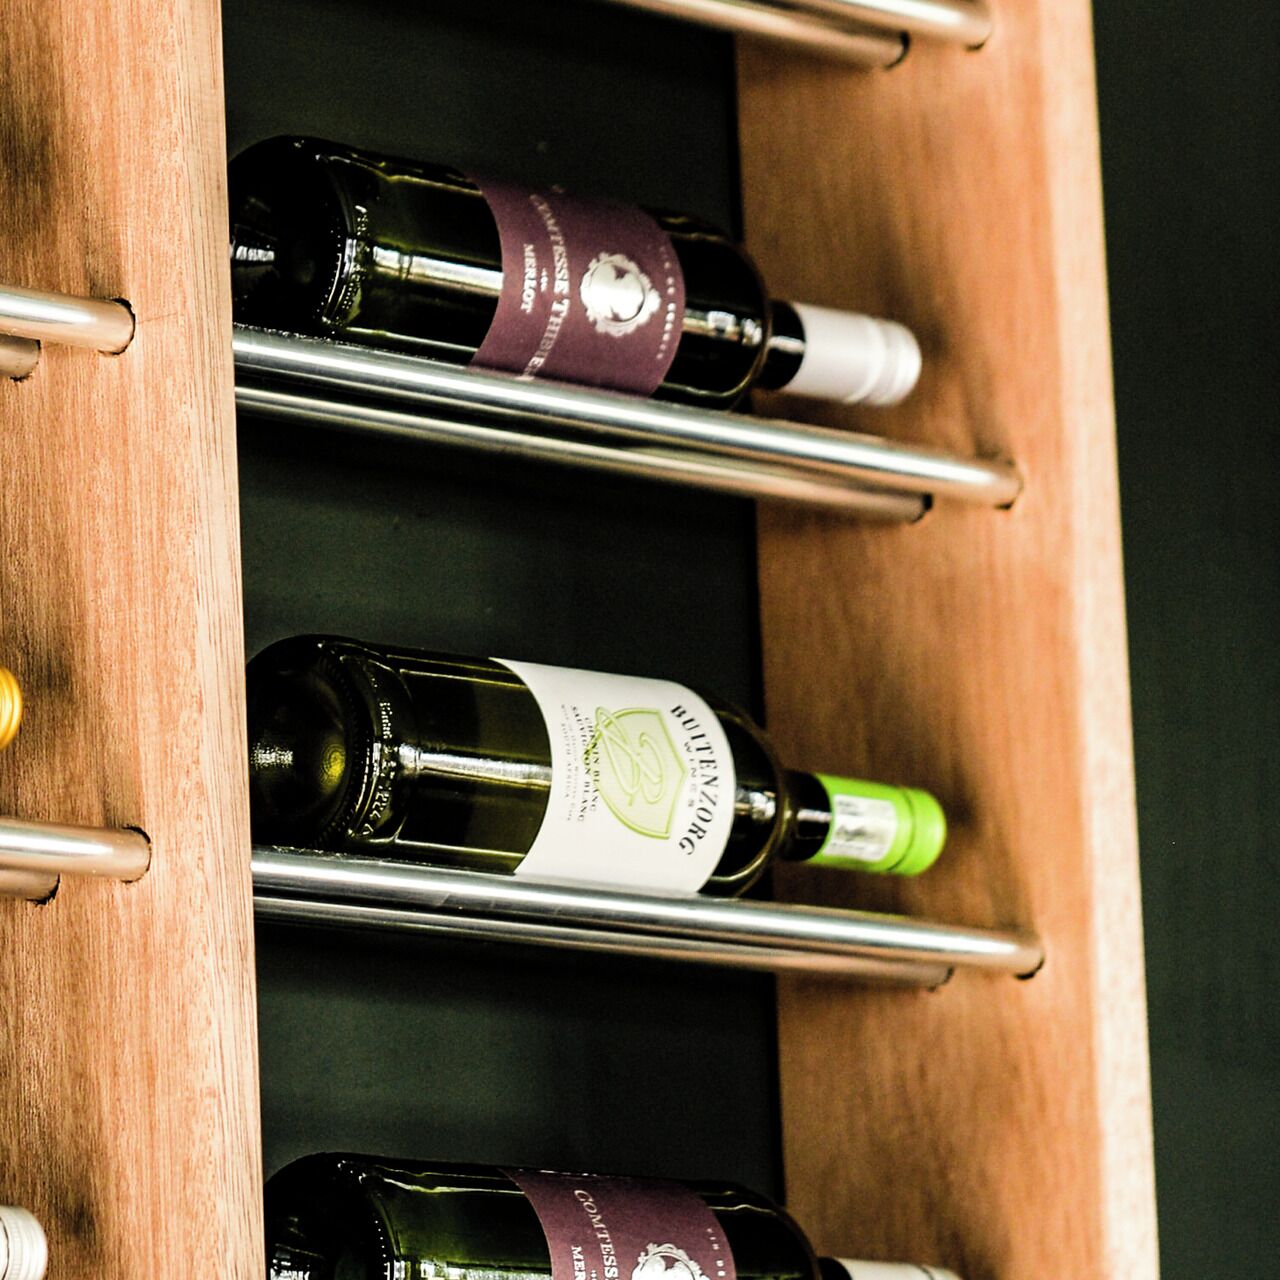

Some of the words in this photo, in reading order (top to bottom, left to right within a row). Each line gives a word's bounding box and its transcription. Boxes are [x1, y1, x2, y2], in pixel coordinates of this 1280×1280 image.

[520, 243, 538, 316] MERLOT
[577, 781, 590, 824] BLANC
[669, 704, 720, 856] BUITENZORG
